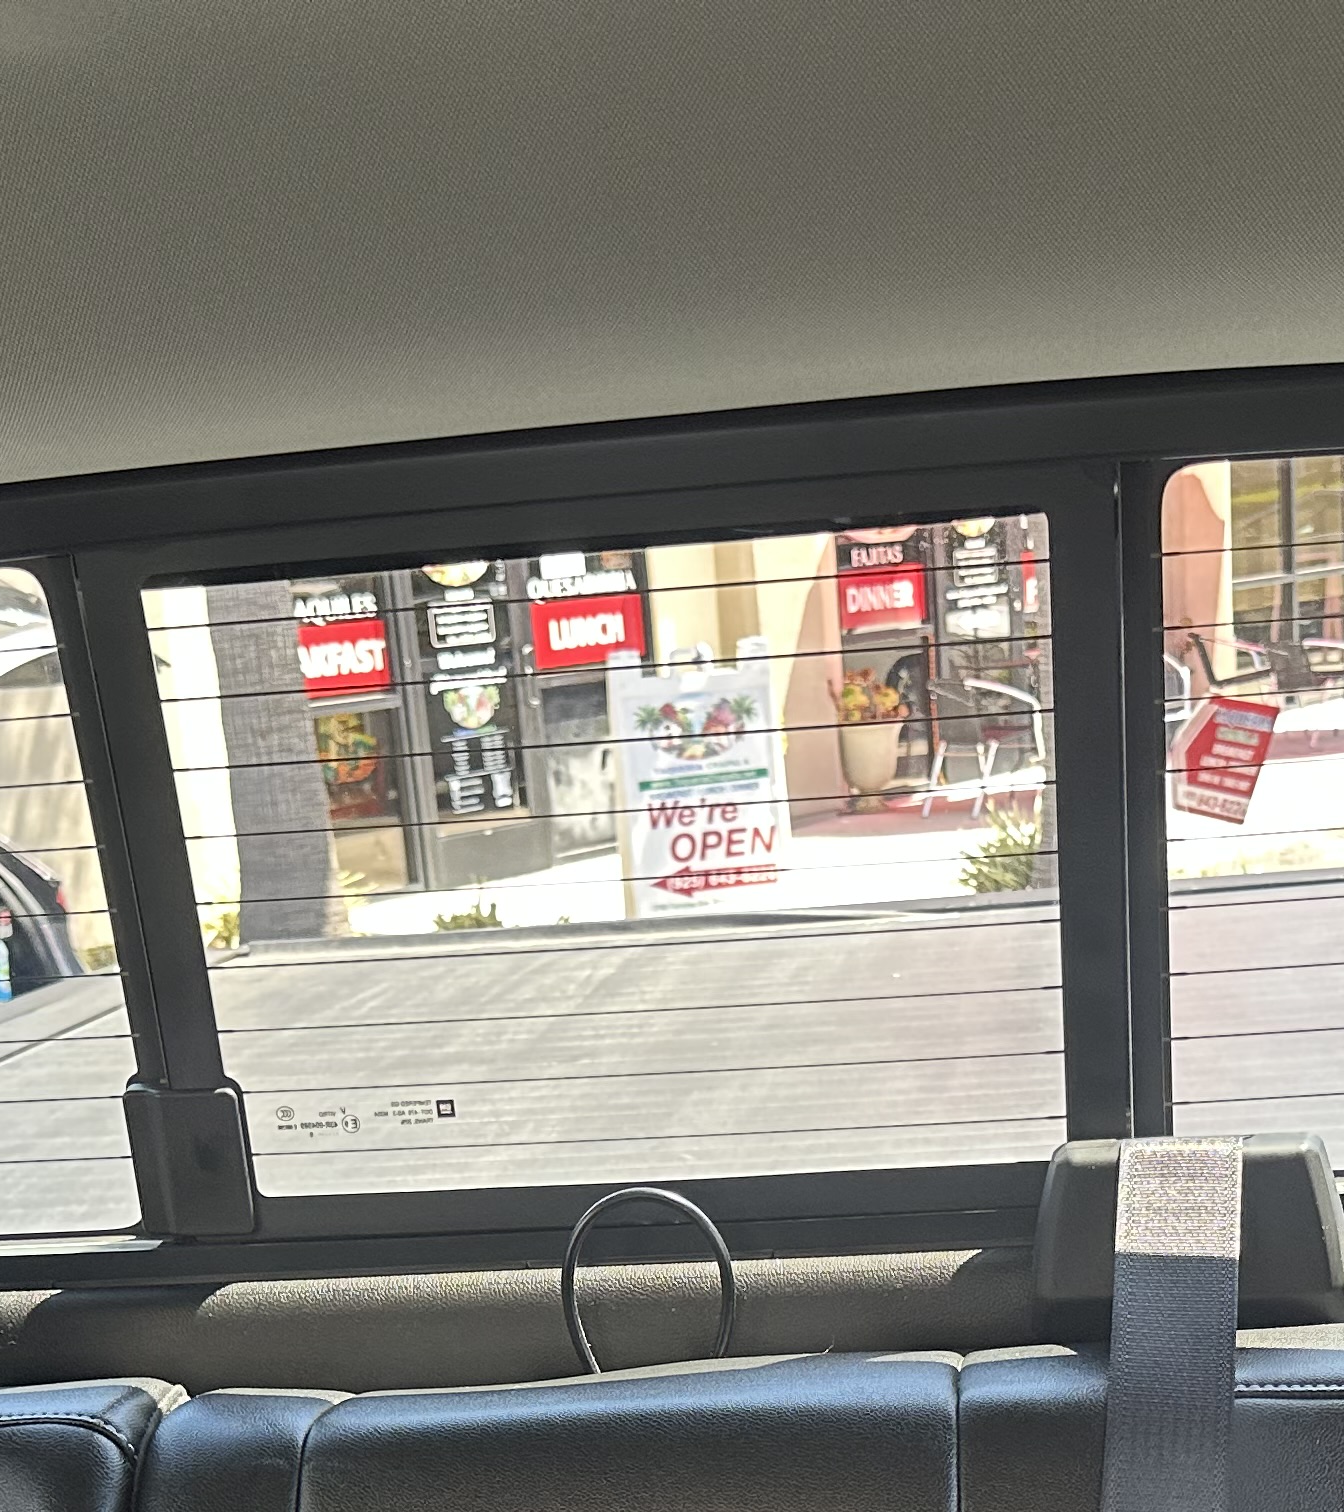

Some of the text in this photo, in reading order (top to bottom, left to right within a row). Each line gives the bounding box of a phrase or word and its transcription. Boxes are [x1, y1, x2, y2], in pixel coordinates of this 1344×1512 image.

[850, 544, 905, 568] FAJITAS
[845, 579, 915, 614] DINNER
[548, 611, 626, 651] LUNCH
[648, 798, 738, 830] We're
[671, 825, 777, 863] OPEN
